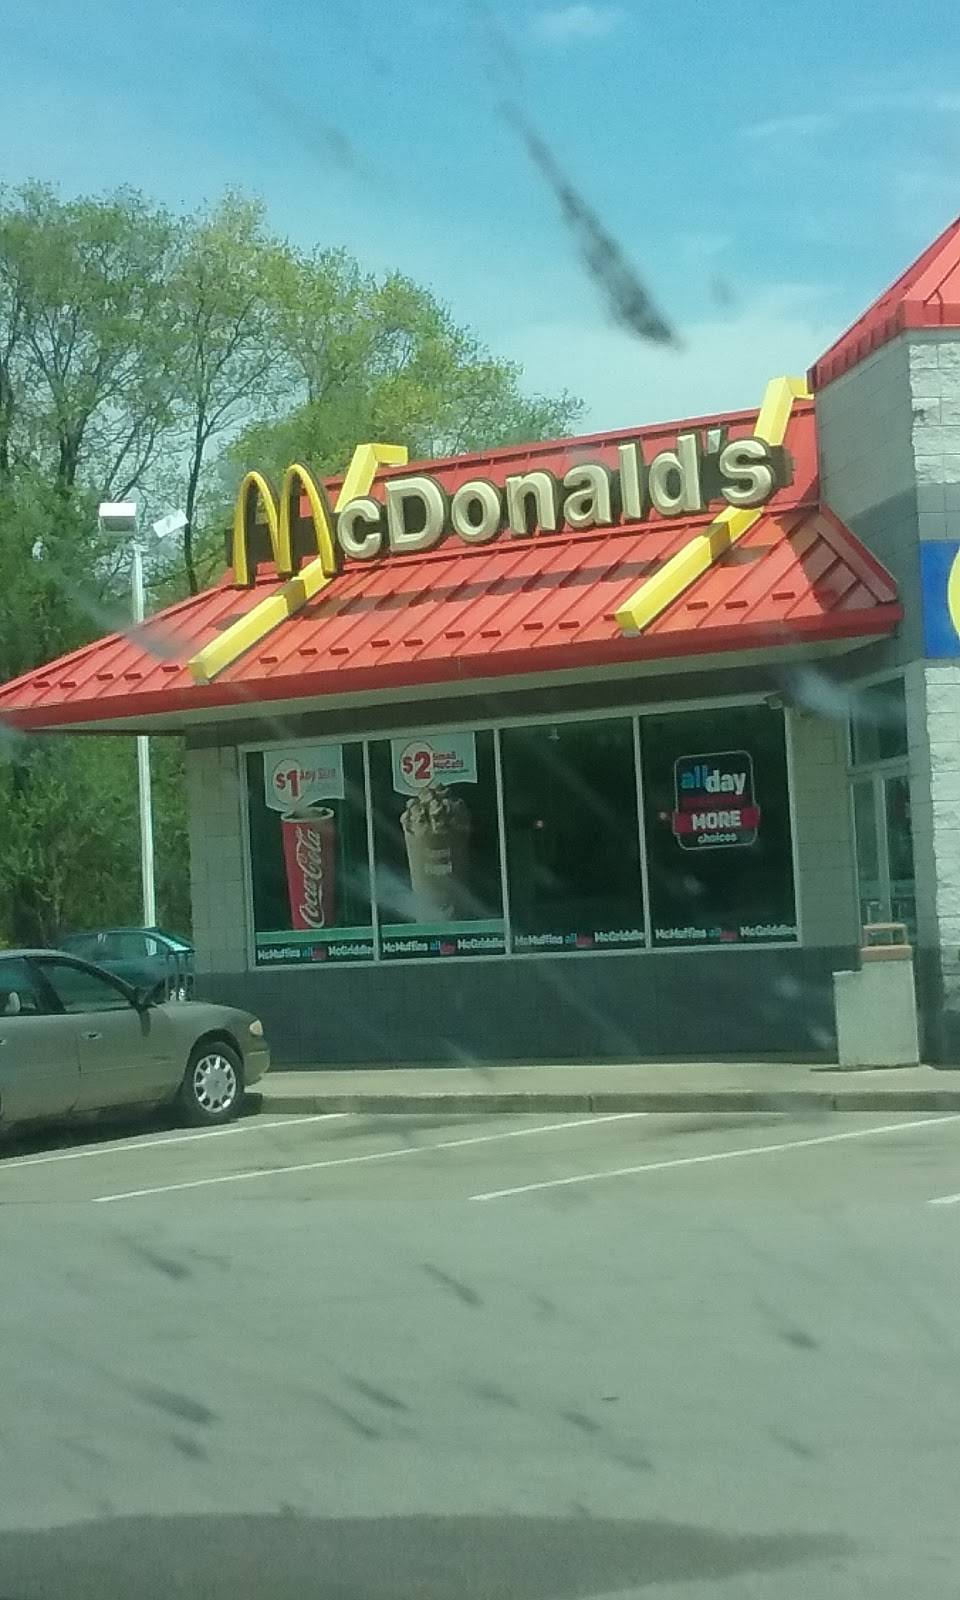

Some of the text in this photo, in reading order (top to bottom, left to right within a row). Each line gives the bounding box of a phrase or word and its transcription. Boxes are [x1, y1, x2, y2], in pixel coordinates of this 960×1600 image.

[233, 433, 774, 585] McDonald's
[402, 751, 431, 780] $2
[276, 769, 299, 797] $1
[692, 810, 742, 831] MORE
[698, 832, 738, 844] choices
